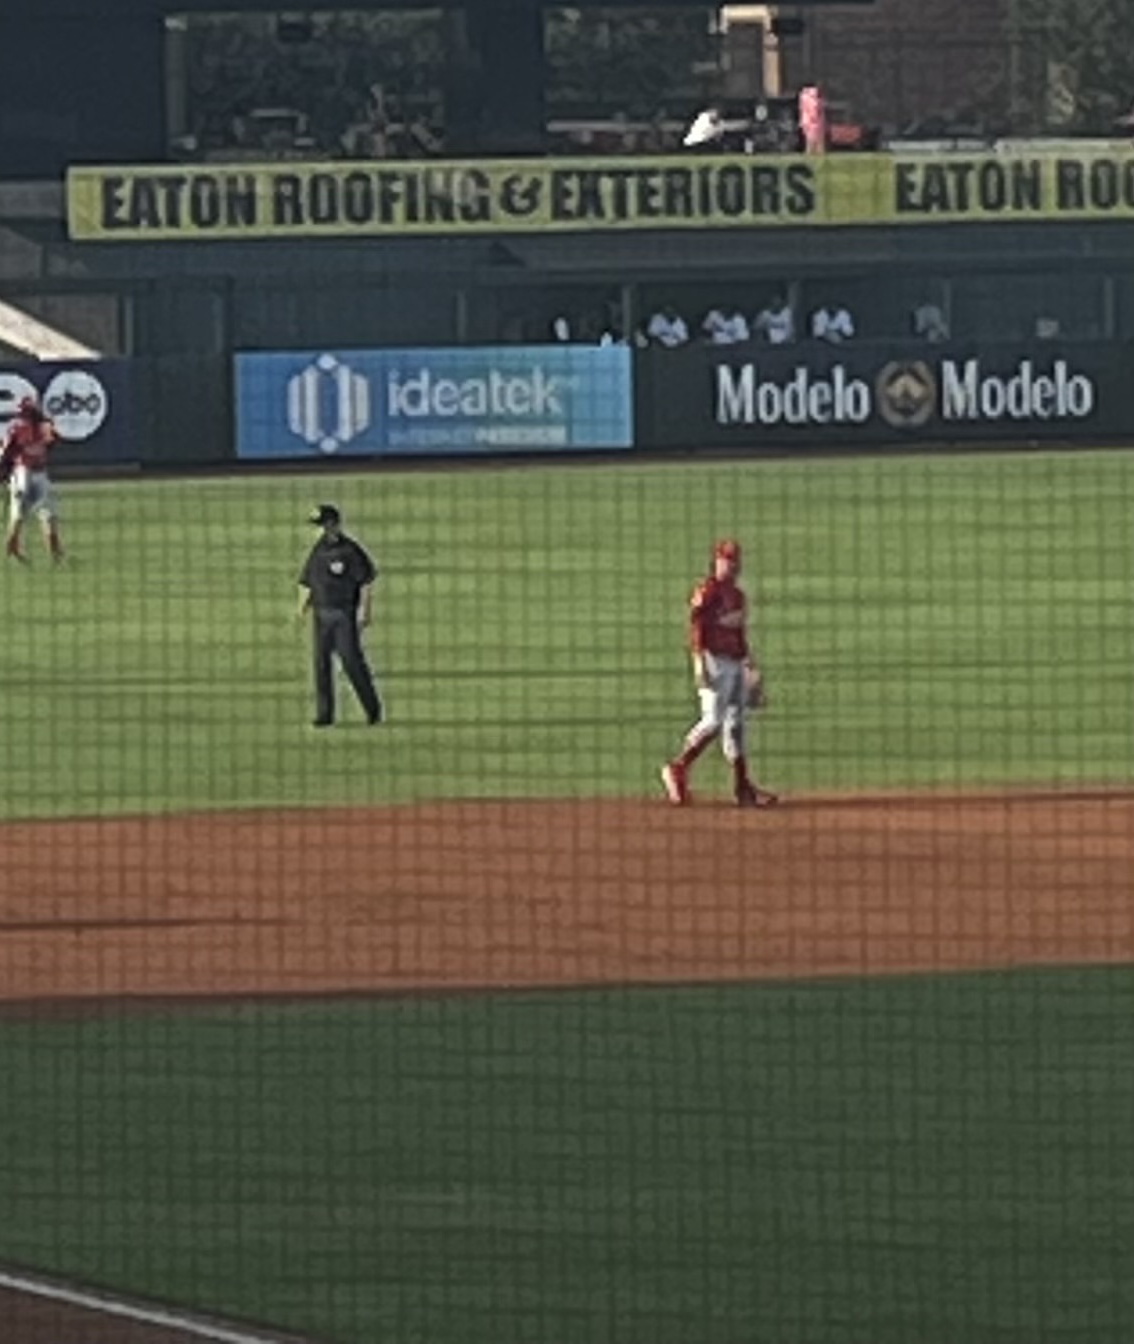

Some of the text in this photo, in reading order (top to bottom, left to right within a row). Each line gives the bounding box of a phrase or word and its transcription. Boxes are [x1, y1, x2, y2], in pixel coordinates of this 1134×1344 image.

[101, 165, 816, 230] EATON ROOFING & EXTERIORS
[895, 162, 1042, 213] EATON
[716, 363, 871, 424] Modelo
[940, 359, 1094, 419] Modelo
